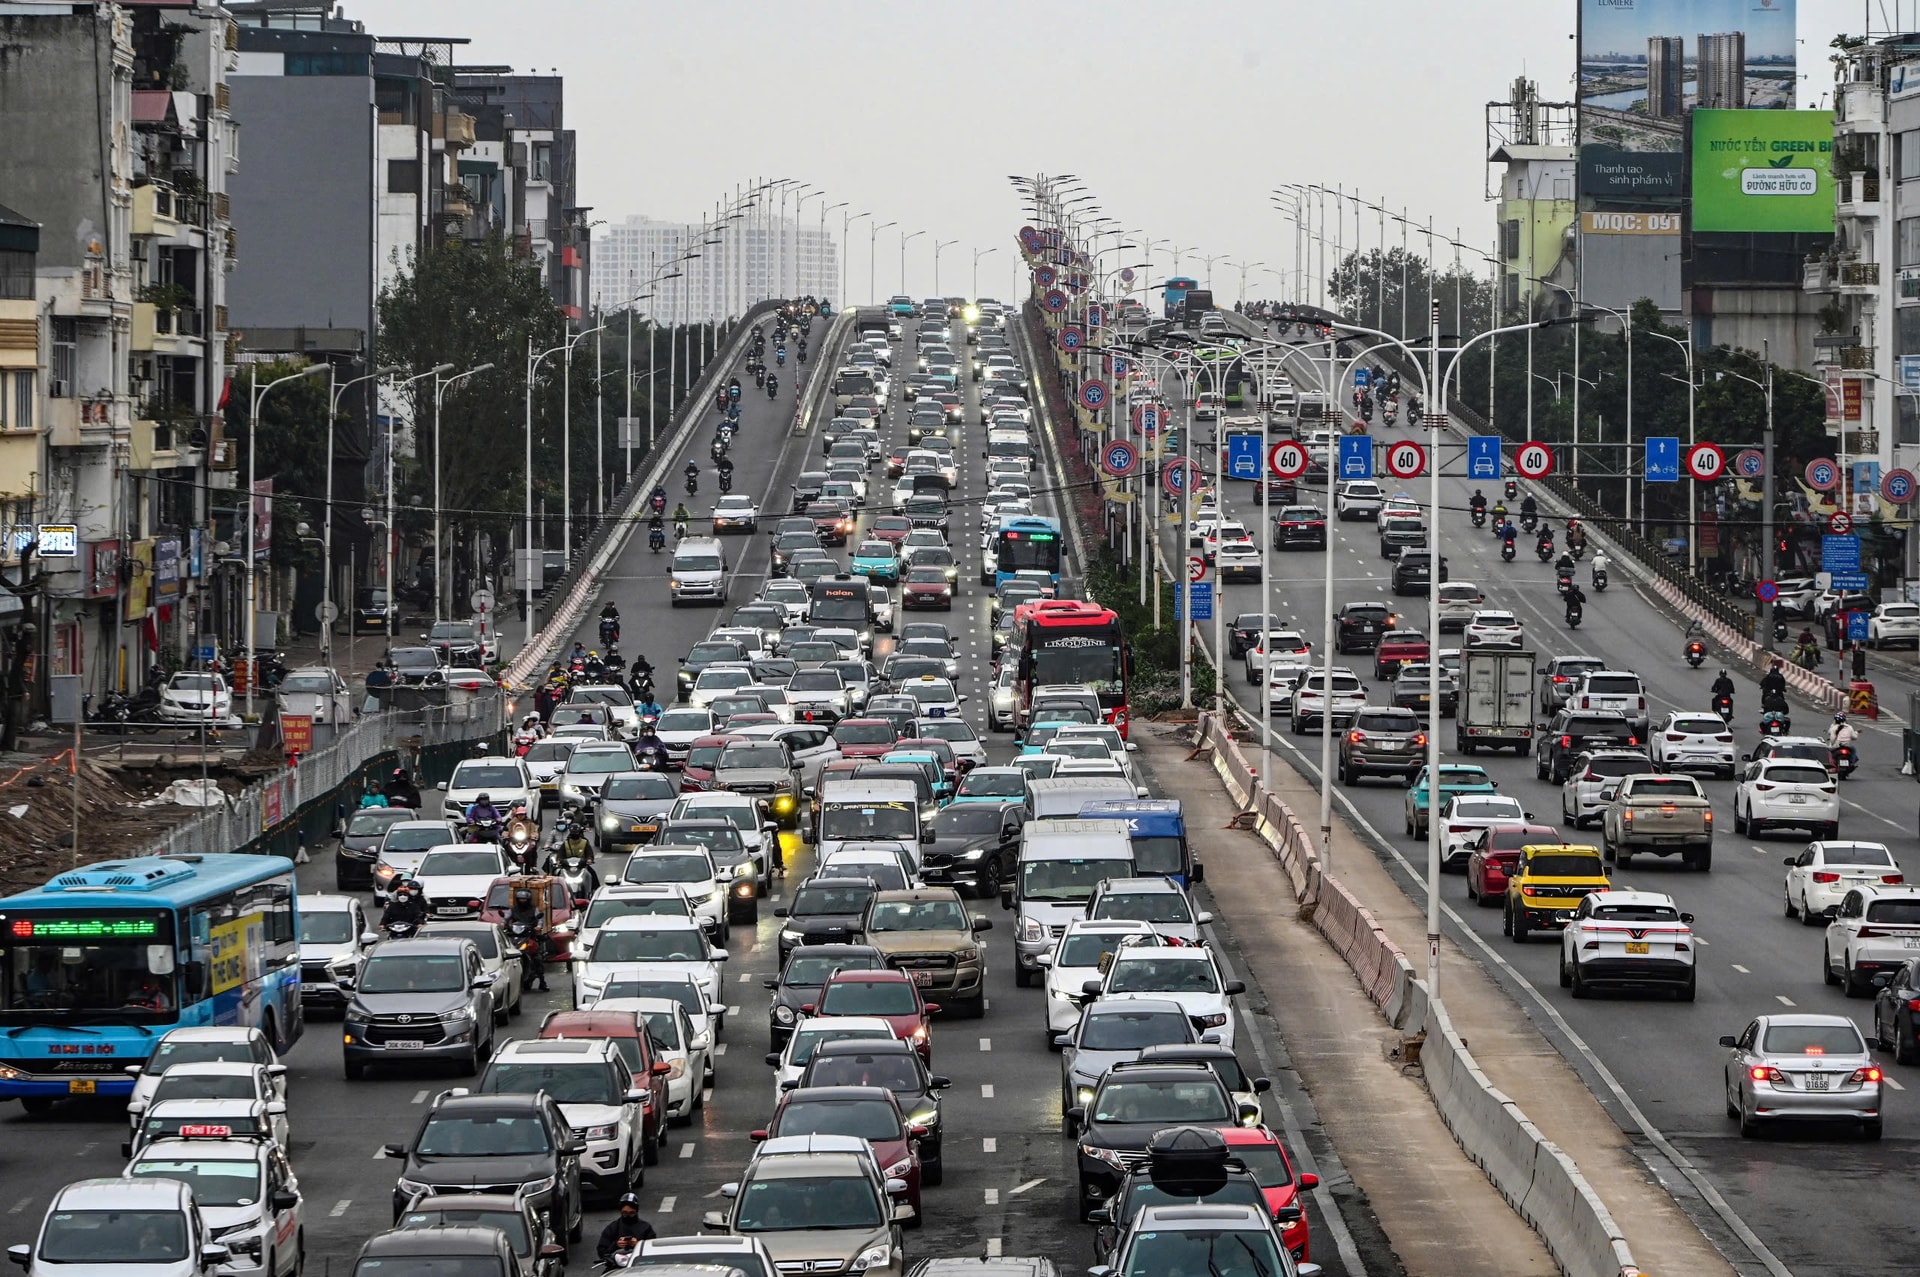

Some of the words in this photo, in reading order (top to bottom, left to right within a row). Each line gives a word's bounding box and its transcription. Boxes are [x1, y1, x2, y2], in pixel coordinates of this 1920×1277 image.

[1770, 140, 1815, 152] GREEN
[1594, 164, 1625, 174] Thanh
[1609, 174, 1631, 185] sinh
[1747, 180, 1777, 191] ĐƯỜNG
[1593, 214, 1642, 233] MQC:
[1281, 451, 1297, 468] 60
[1398, 451, 1414, 468] 60
[1526, 452, 1542, 469] 60
[1697, 453, 1715, 470] 40
[1044, 639, 1107, 649] LIMOUSINE
[206, 1125, 227, 1135] 123
